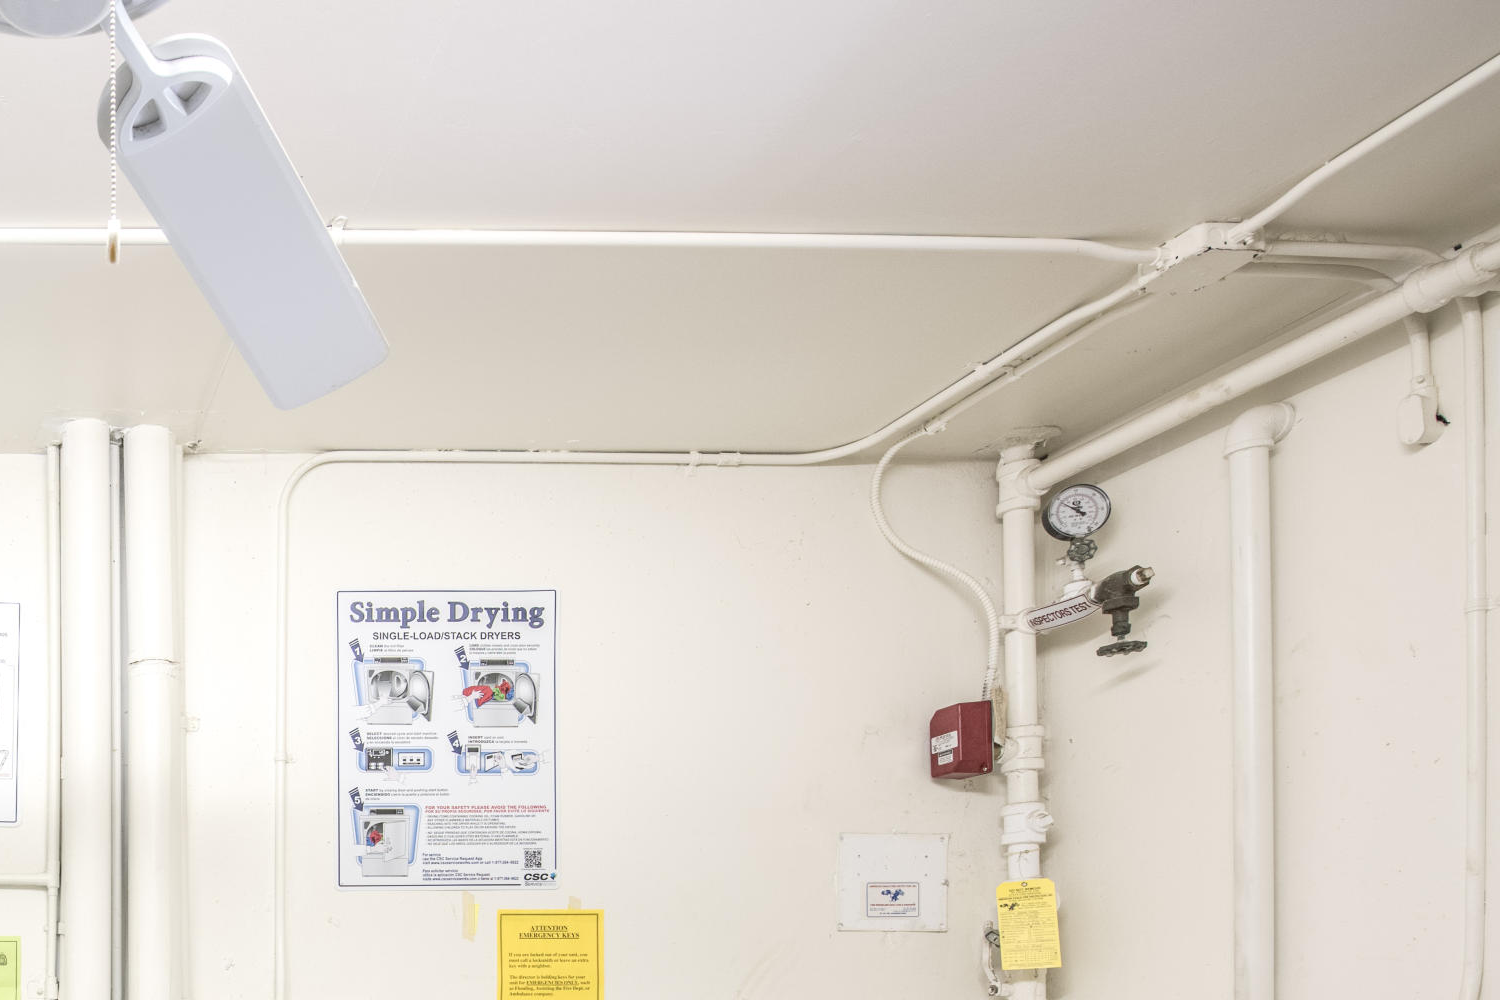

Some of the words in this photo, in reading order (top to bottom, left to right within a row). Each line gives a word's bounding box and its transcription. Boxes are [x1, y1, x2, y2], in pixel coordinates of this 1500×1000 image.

[1069, 601, 1091, 614] TEST
[349, 600, 440, 629] Simple
[447, 601, 545, 629] Drying
[372, 631, 477, 640] SINGLE-LOAD/STACK
[480, 631, 521, 640] DRYERS
[523, 873, 549, 881] CSC
